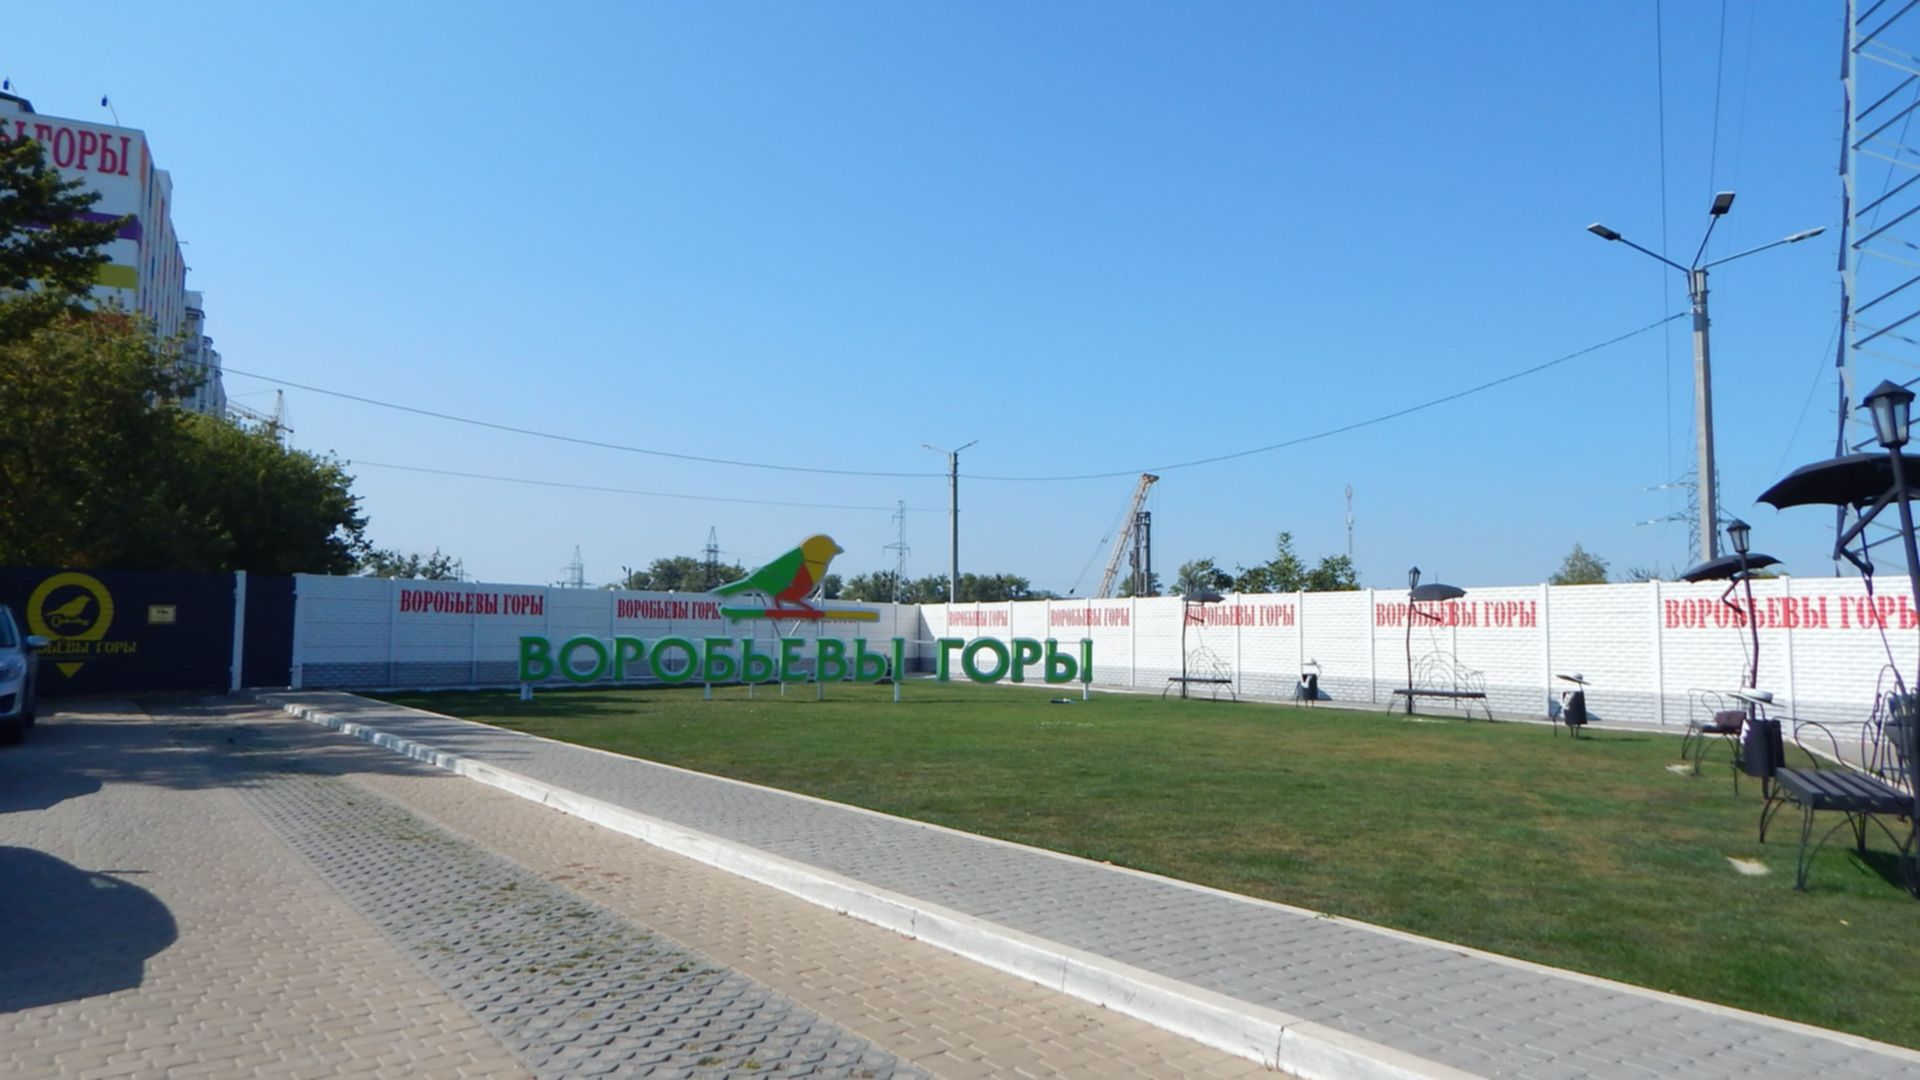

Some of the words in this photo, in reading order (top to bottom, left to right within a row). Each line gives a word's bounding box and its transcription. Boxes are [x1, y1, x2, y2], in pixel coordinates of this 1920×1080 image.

[400, 589, 498, 615] ВОРОБЬЕВЫ
[503, 593, 544, 615] ГОРЫ
[617, 599, 689, 620] ВОРОБЬЕВЫ
[1484, 600, 1537, 627] ГОРЫ
[1104, 607, 1130, 626] ГОРЫ
[1259, 604, 1295, 626] ГОРЫ
[519, 636, 905, 684] ВОРОБЬЕВЫ
[936, 637, 1094, 684] ГОРЫ
